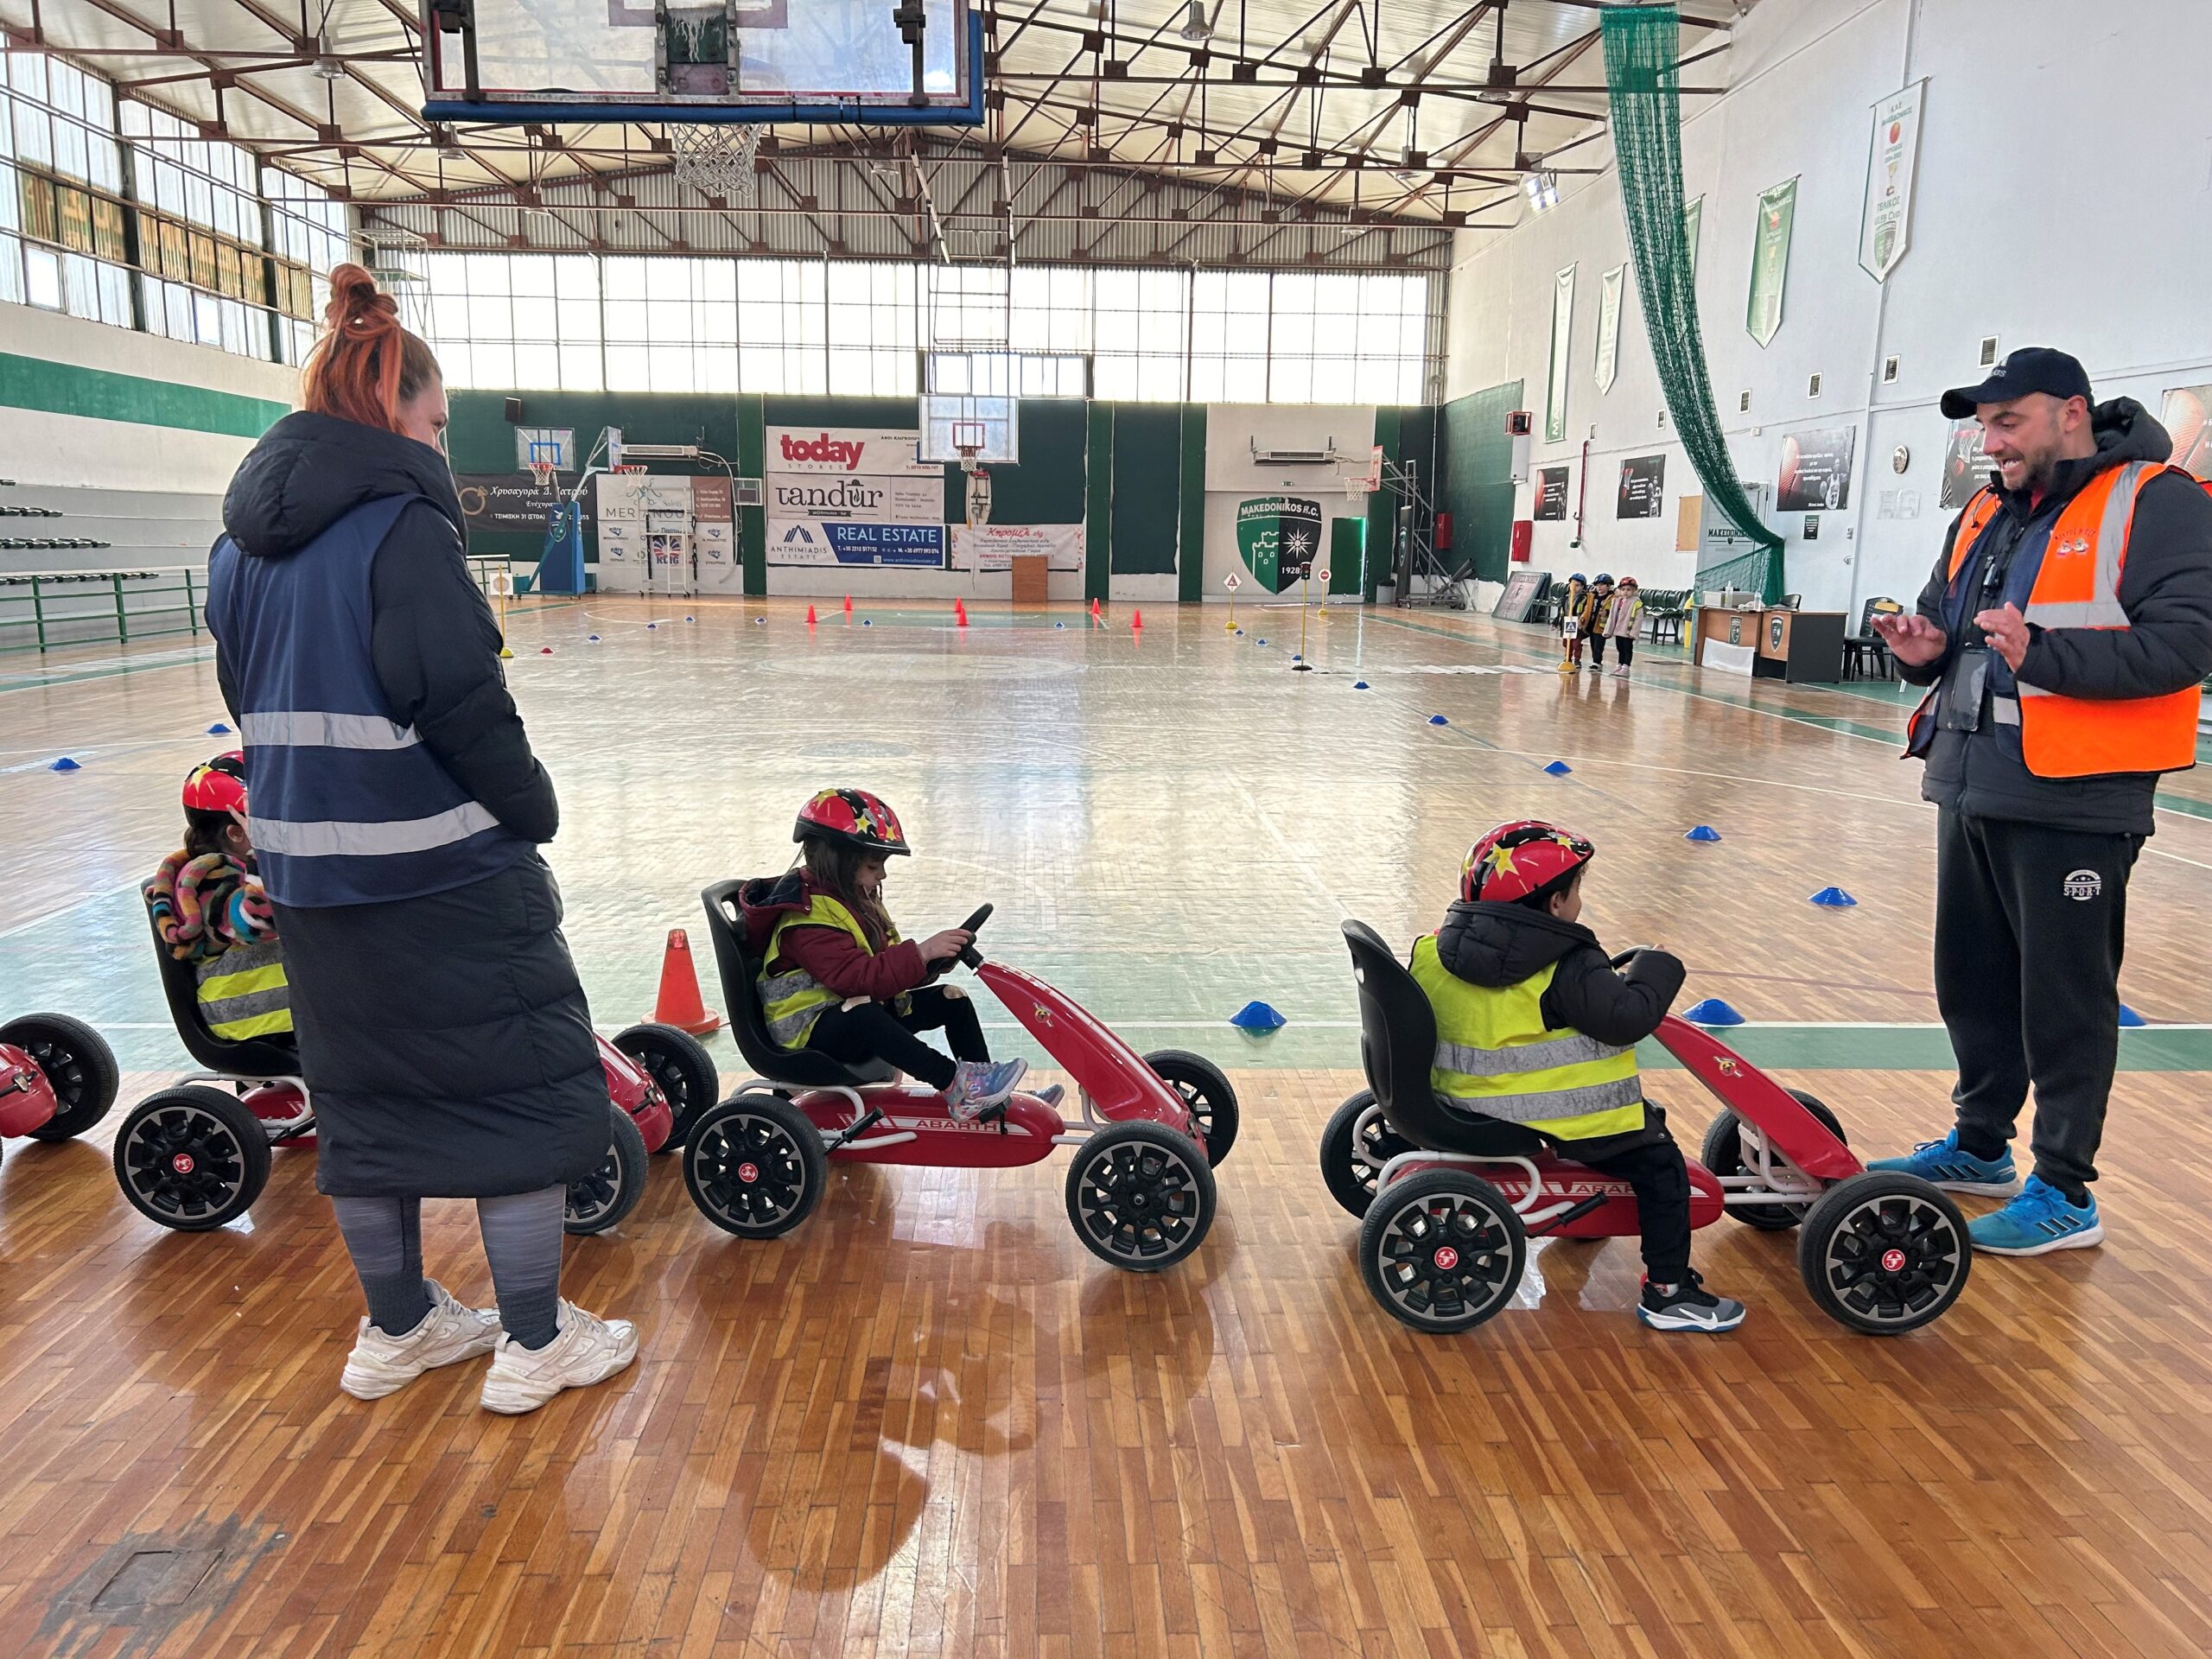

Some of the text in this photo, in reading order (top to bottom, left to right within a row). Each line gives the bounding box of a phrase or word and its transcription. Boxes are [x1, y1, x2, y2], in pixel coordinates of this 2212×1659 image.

[780, 433, 865, 471] today
[1241, 503, 1302, 515] MAKEDONIKOS
[837, 526, 937, 543] REAL ESTATE
[916, 1120, 997, 1131] ABARTH
